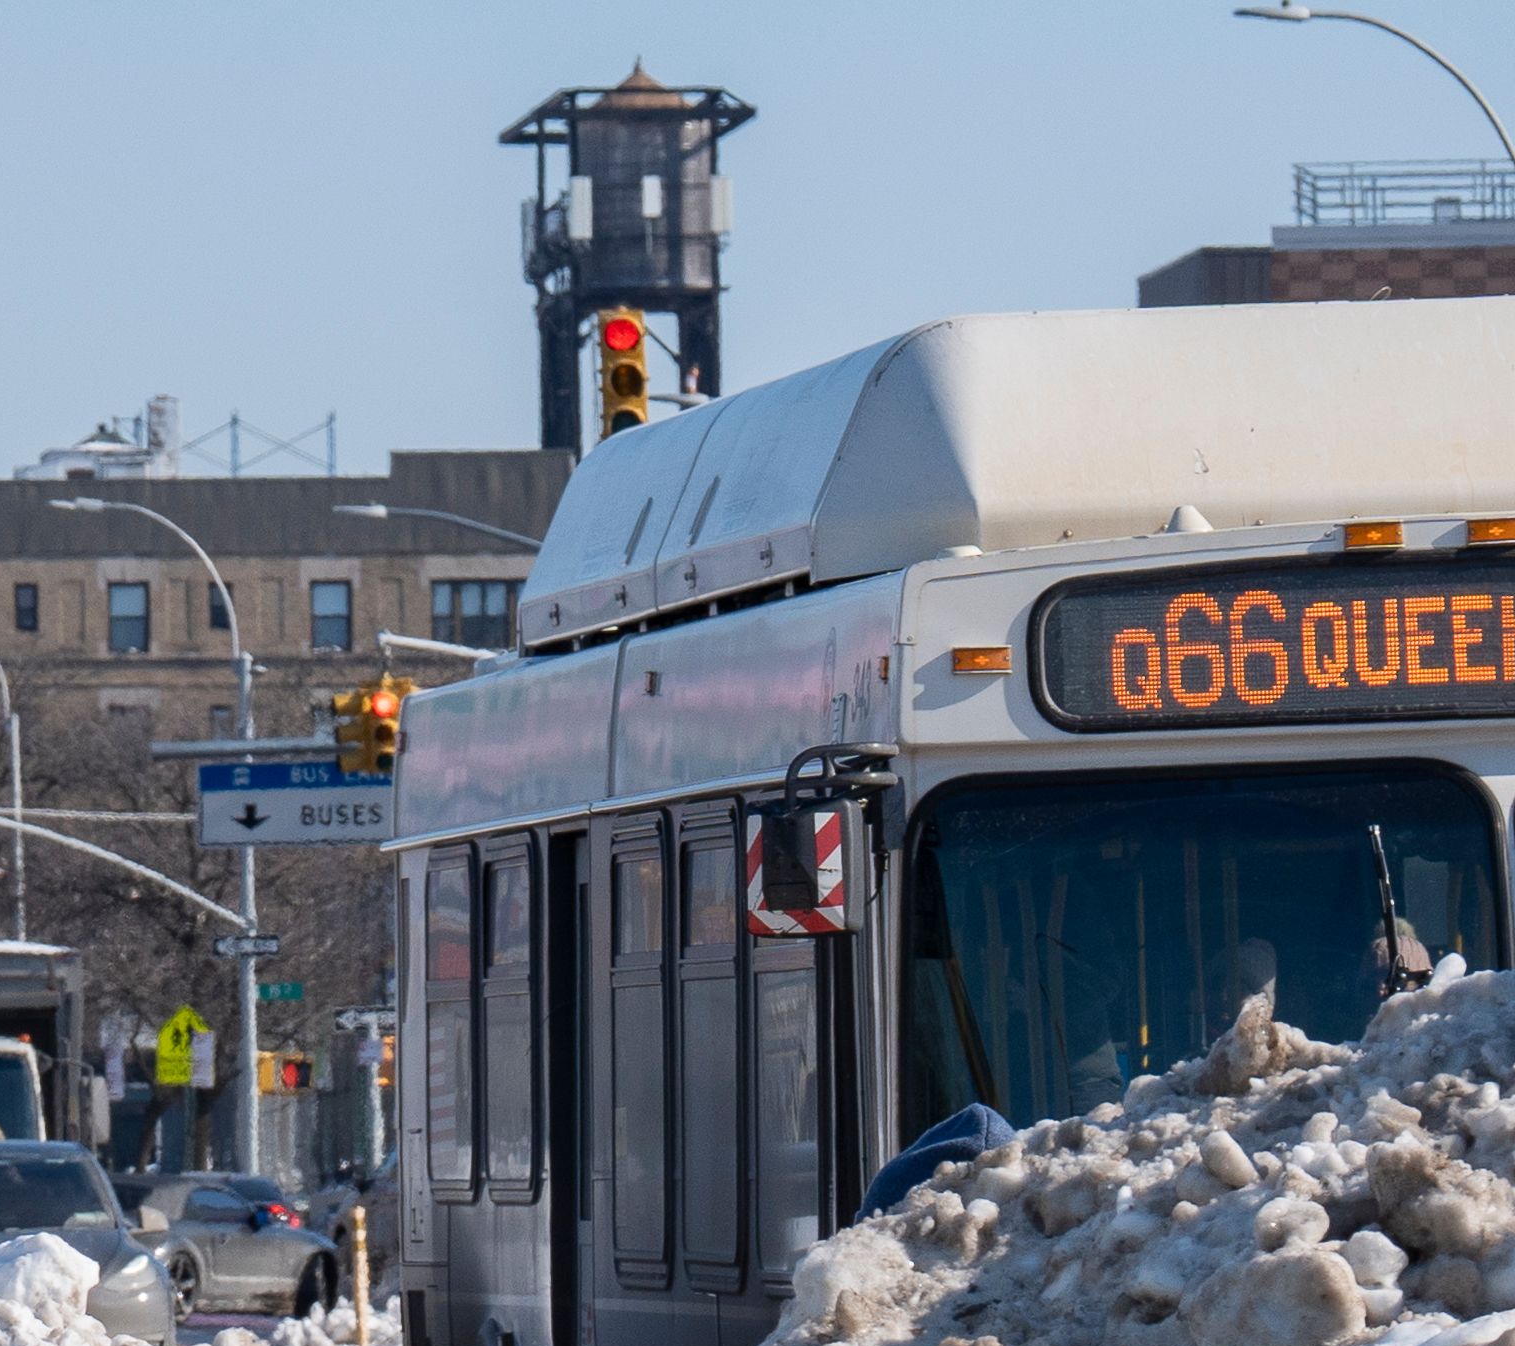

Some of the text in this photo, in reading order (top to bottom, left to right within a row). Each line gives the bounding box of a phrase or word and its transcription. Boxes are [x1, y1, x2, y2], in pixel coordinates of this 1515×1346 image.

[1110, 589, 1290, 712] Q66
[289, 767, 331, 784] BUS
[300, 803, 384, 827] BUSES
